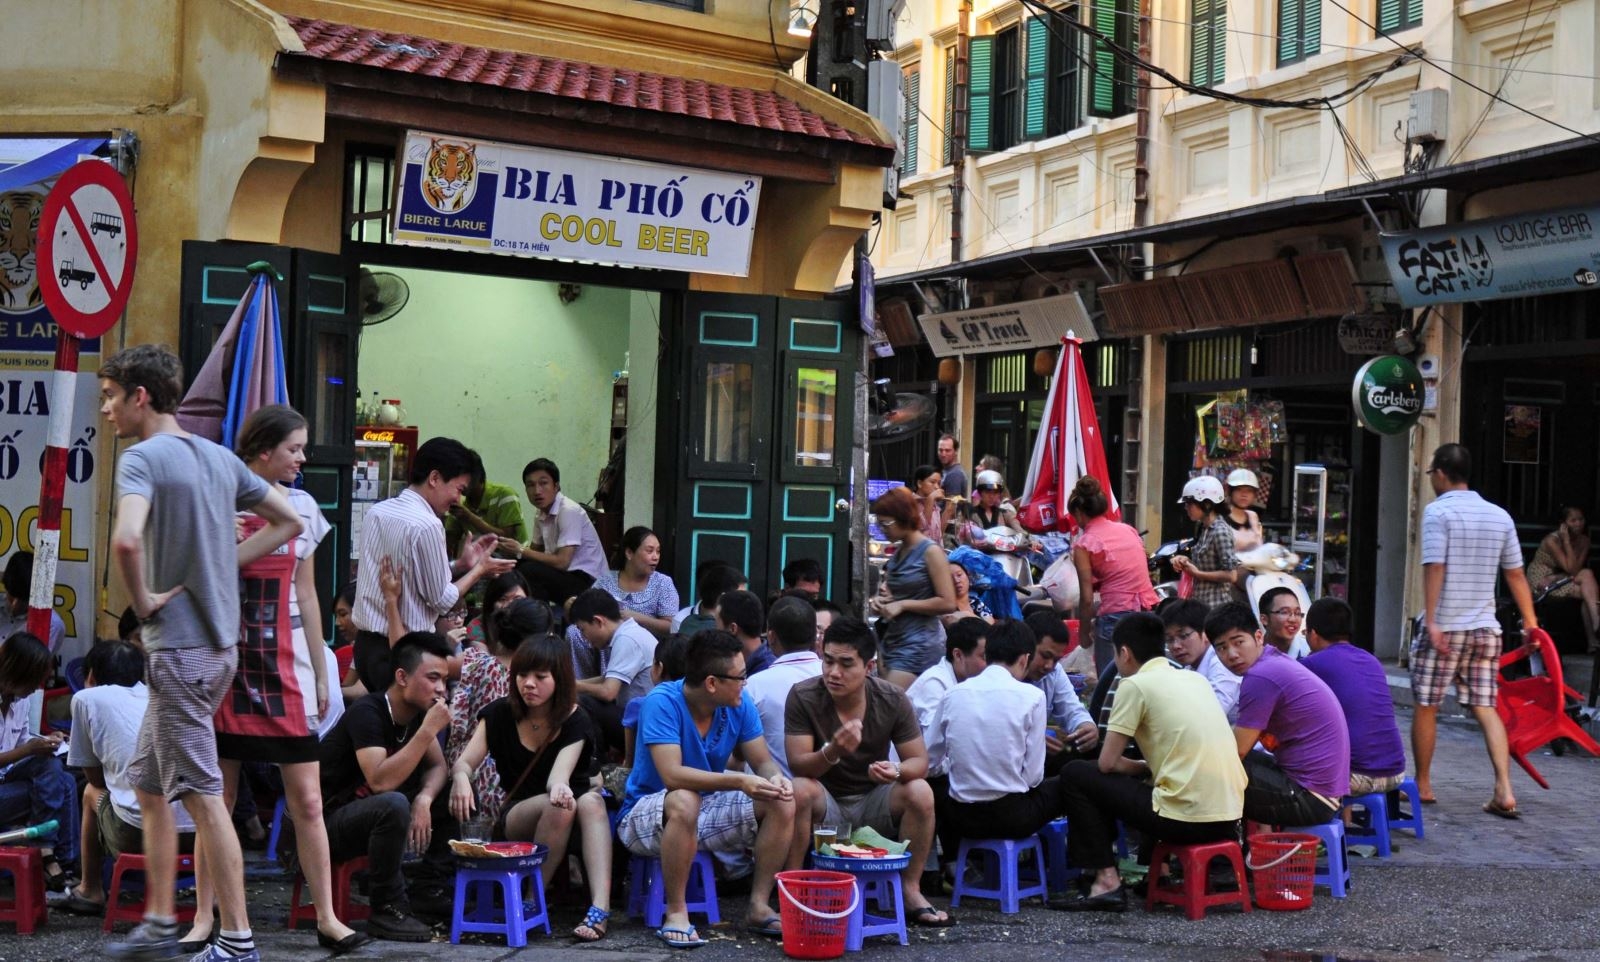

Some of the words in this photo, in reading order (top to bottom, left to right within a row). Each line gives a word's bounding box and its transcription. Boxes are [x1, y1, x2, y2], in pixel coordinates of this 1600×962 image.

[502, 166, 577, 206] BIA
[598, 175, 689, 218] PHỐ
[701, 179, 755, 227] CỔ
[403, 213, 441, 227] BIERE
[444, 218, 487, 232] LARUE
[539, 212, 622, 248] COOL
[637, 223, 710, 257] BEER
[1494, 218, 1556, 244] LOUNGE
[1558, 213, 1592, 235] BAR
[1398, 239, 1457, 278] FAT
[1415, 271, 1458, 296] CAT
[16, 322, 58, 338] LAR
[980, 317, 1029, 342] Travel
[25, 357, 49, 367] 1909
[0, 380, 49, 416] IA
[1367, 385, 1420, 413] Carlsberg
